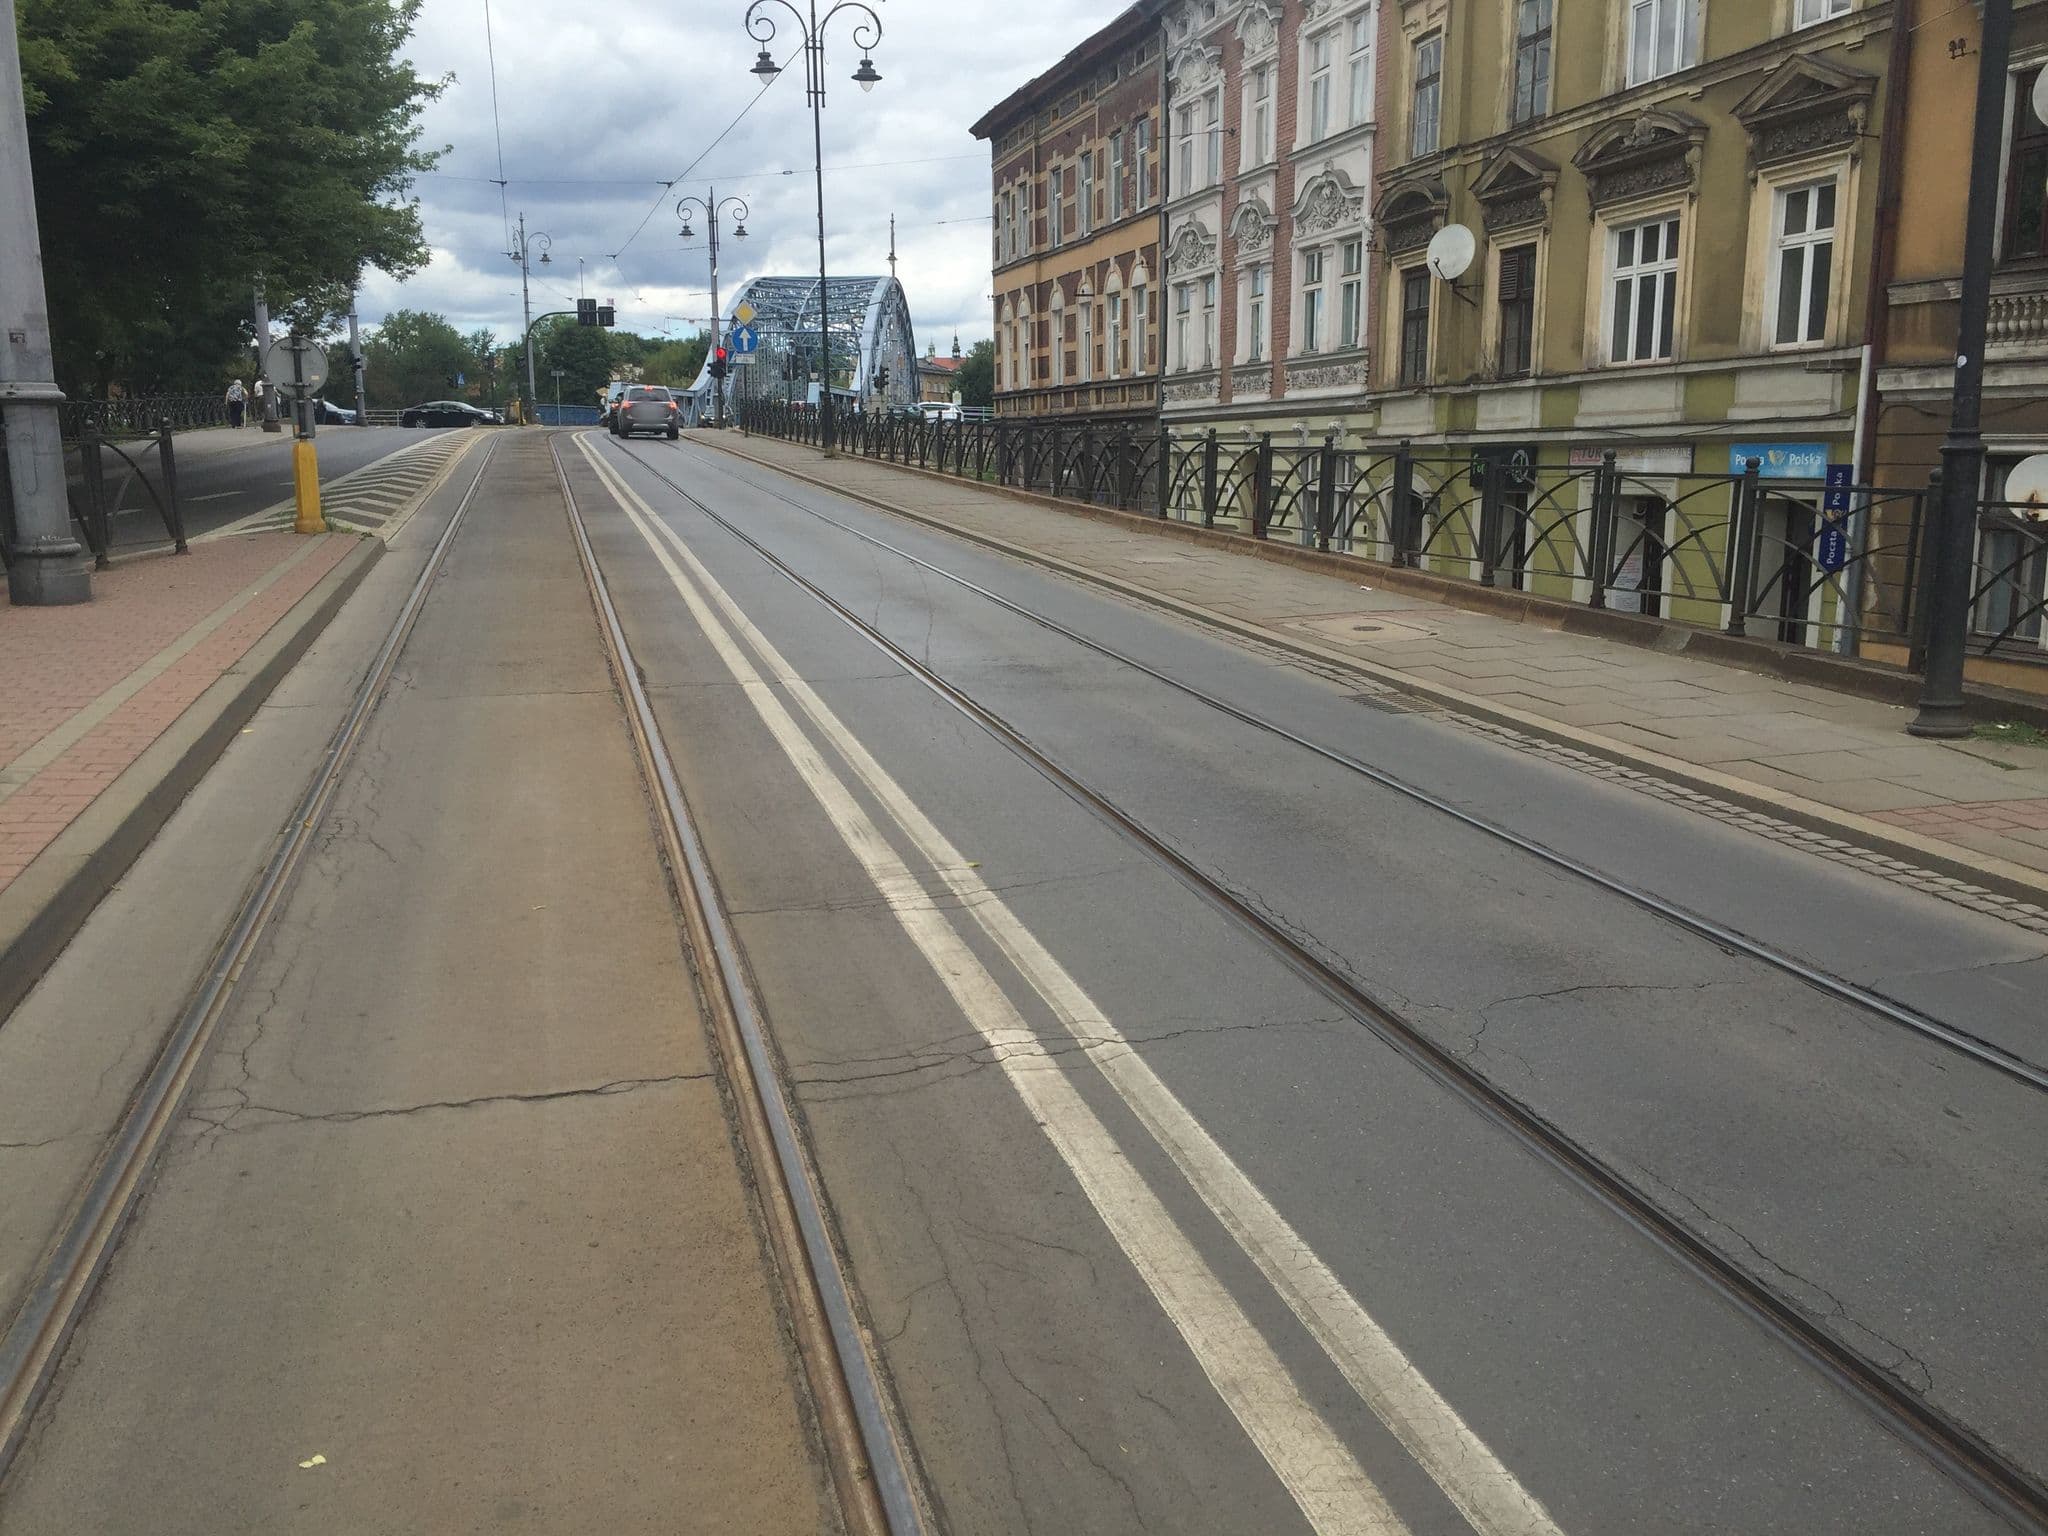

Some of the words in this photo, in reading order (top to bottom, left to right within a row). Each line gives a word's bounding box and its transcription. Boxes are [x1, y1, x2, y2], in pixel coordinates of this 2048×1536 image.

[1735, 453, 1765, 465] Poa
[1789, 453, 1822, 465] Polska
[1826, 530, 1838, 564] Poczta
[1832, 472, 1843, 505] Poka
